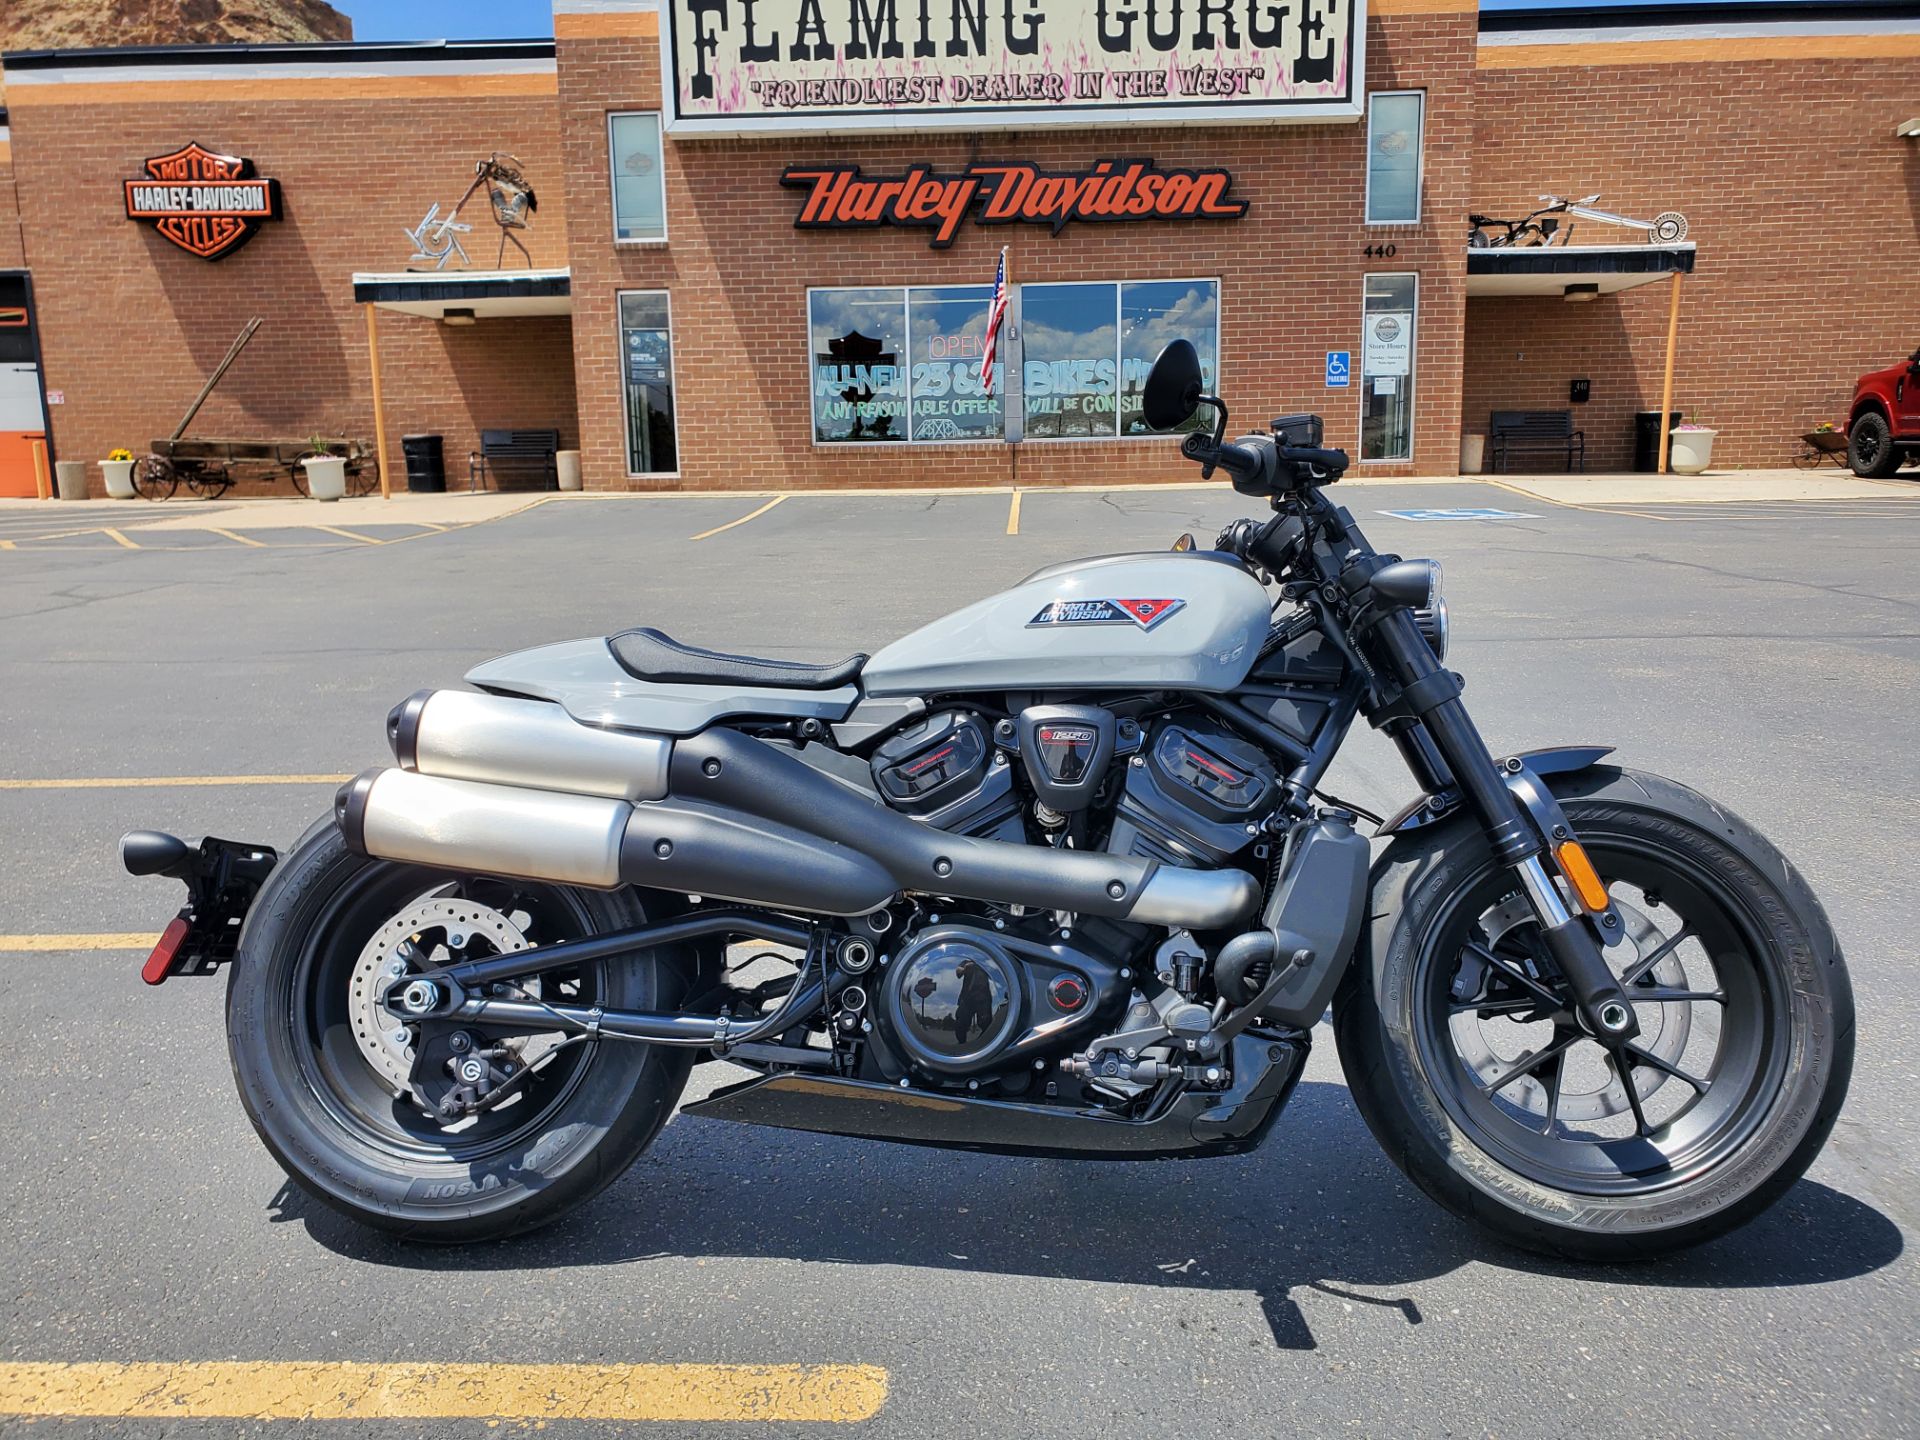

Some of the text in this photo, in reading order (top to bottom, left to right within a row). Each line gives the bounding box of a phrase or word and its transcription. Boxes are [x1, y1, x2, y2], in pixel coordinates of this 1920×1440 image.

[687, 0, 1335, 99] FLAMING GORGE
[750, 64, 1264, 108] "FRIENDLIEST DEALER IN THE WEST"
[161, 153, 230, 180] MOTOR
[133, 186, 265, 211] HARLEY-DAVIDSON
[786, 163, 1241, 241] Harley-Davidson
[167, 217, 236, 250] CYCLES
[1363, 244, 1397, 259] 440
[931, 335, 985, 357] OPEN
[1024, 359, 1116, 396] BIKES
[821, 401, 853, 420] ANY
[952, 399, 1002, 416] OFFER
[1023, 397, 1062, 414] WILL
[1063, 398, 1080, 410] BE
